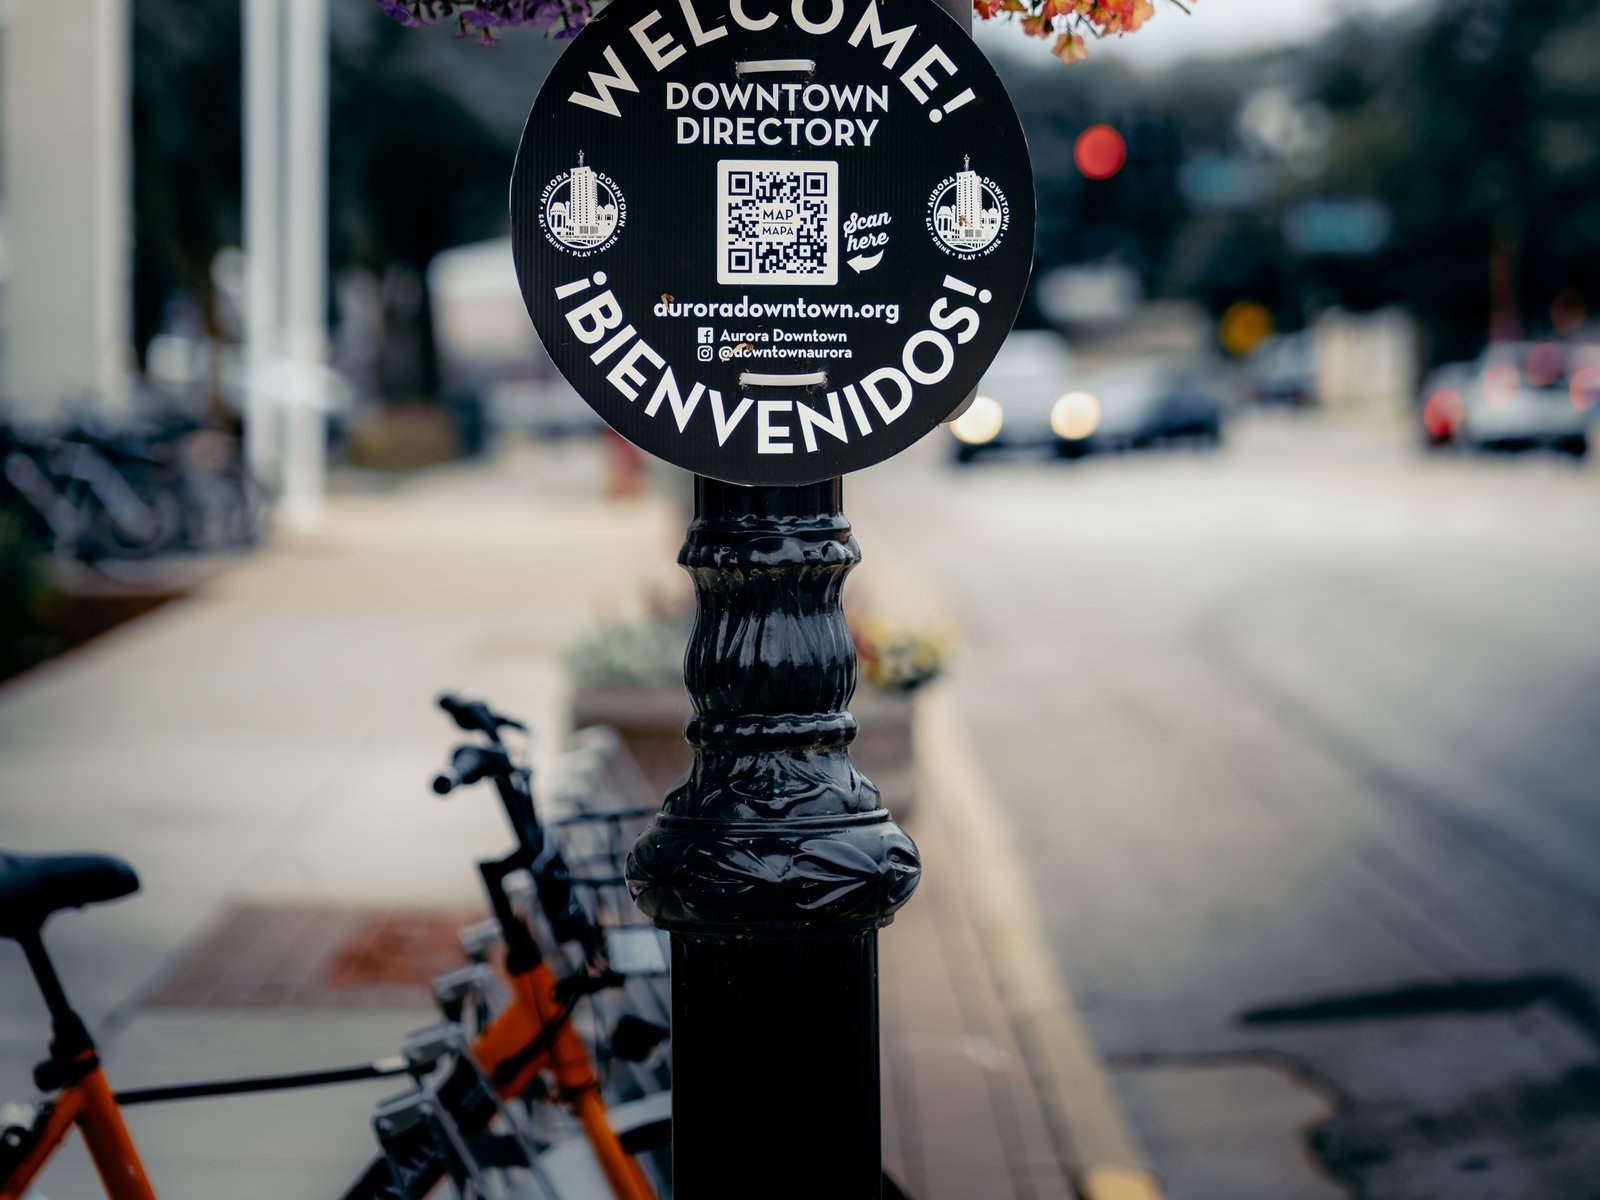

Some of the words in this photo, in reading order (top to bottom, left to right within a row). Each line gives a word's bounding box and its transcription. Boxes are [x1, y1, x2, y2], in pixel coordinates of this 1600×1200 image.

[666, 82, 889, 113] DOWNTOWN
[677, 116, 880, 147] DIRECTORY
[540, 172, 569, 204] AURORA
[598, 172, 627, 227] DOWNTOWN
[762, 209, 794, 220] MAP
[927, 175, 955, 208] AURORA
[983, 176, 1010, 231] DOWNTOWN
[538, 213, 546, 227] EAT
[545, 233, 565, 252] DRINK
[572, 250, 592, 258] PLAY
[599, 235, 619, 253] MORE
[762, 226, 794, 236] MAPA
[843, 212, 892, 238] Scan
[925, 217, 933, 231] EAT
[932, 236, 951, 255] DRINK
[958, 253, 977, 261] PLAY
[983, 238, 1002, 256] MORE
[846, 232, 890, 252] here
[653, 295, 900, 325] auroradowntown.org
[720, 329, 769, 343] Aurora
[773, 328, 848, 343] Downtown
[554, 270, 993, 455] ¡BIENVENIDOS!
[718, 345, 853, 362] @downtownaurora
